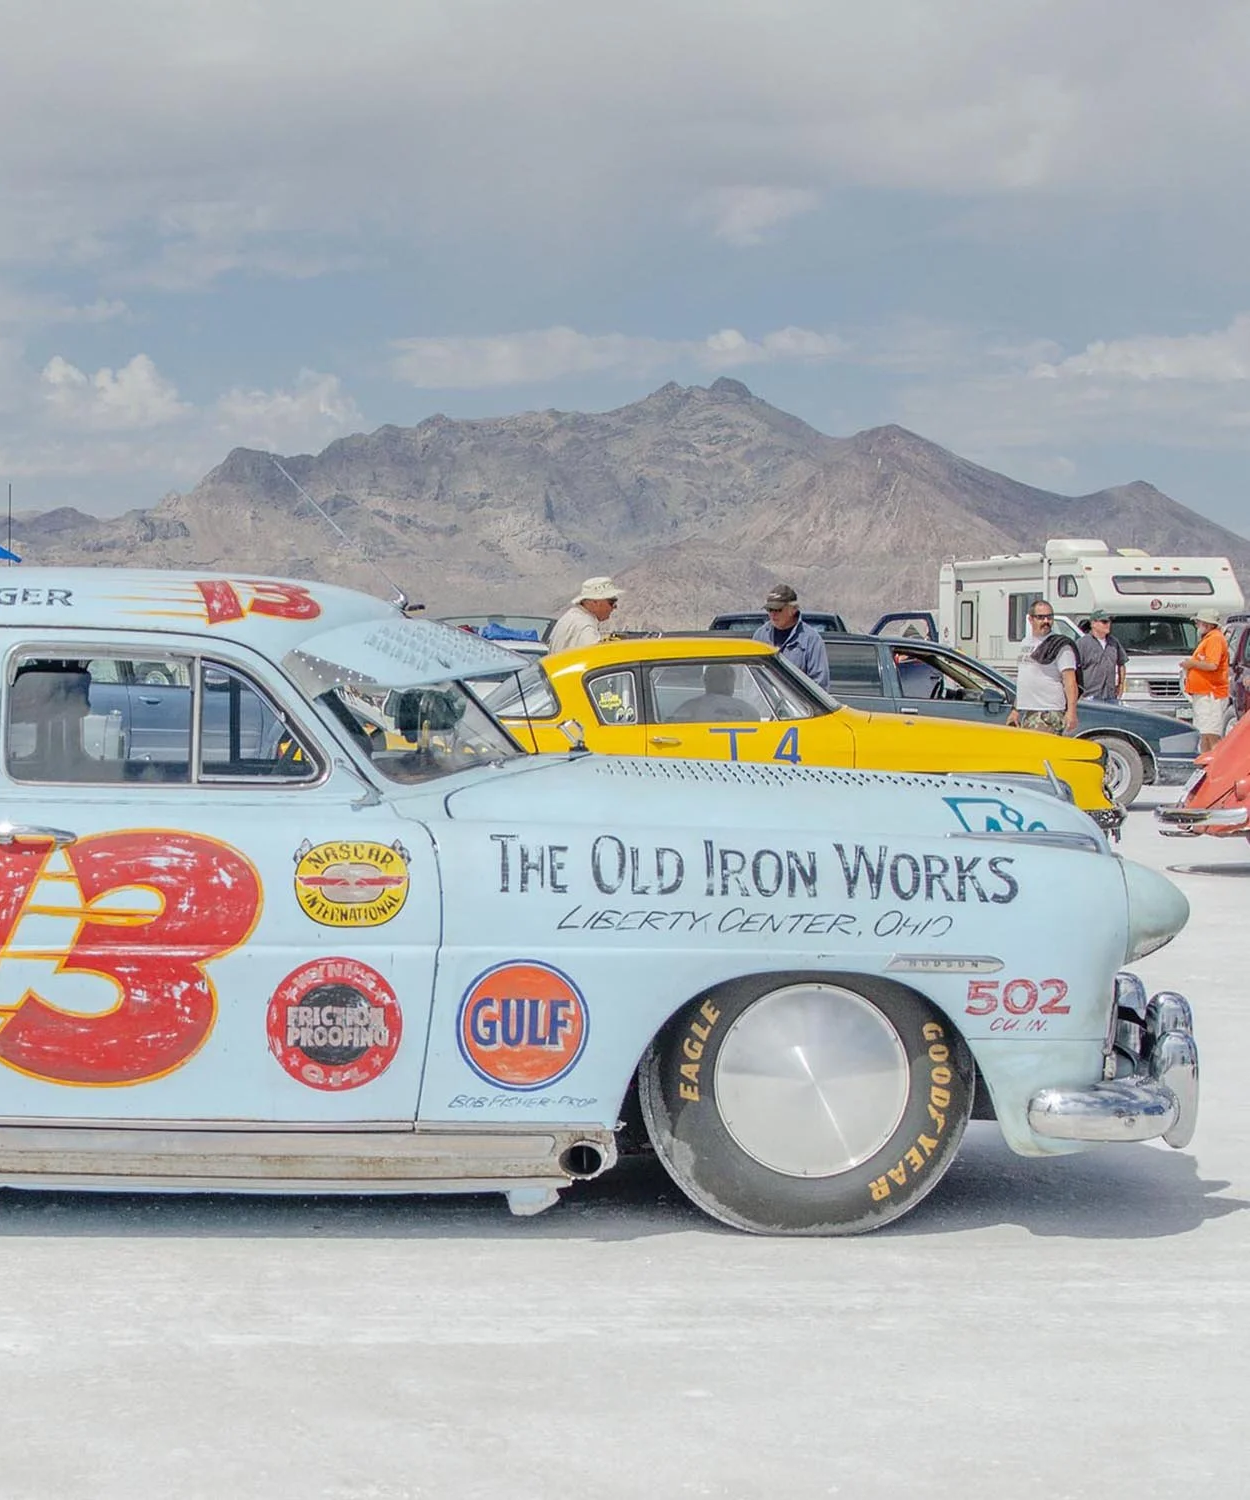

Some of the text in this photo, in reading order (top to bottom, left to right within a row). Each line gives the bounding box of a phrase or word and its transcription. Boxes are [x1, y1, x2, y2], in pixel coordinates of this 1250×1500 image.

[193, 577, 324, 627] 13
[308, 843, 395, 869] NASCAR
[489, 833, 1020, 905] THE OLD IRON WORKS
[305, 891, 400, 922] INTERNATIONAL
[874, 910, 954, 937] OHIO
[965, 978, 1071, 1016] 502
[287, 1006, 385, 1028] FRICTION
[470, 997, 576, 1052] GULF
[287, 1026, 389, 1047] PROOFING
[679, 1000, 722, 1102] EAGLE
[301, 1063, 370, 1087] OIL
